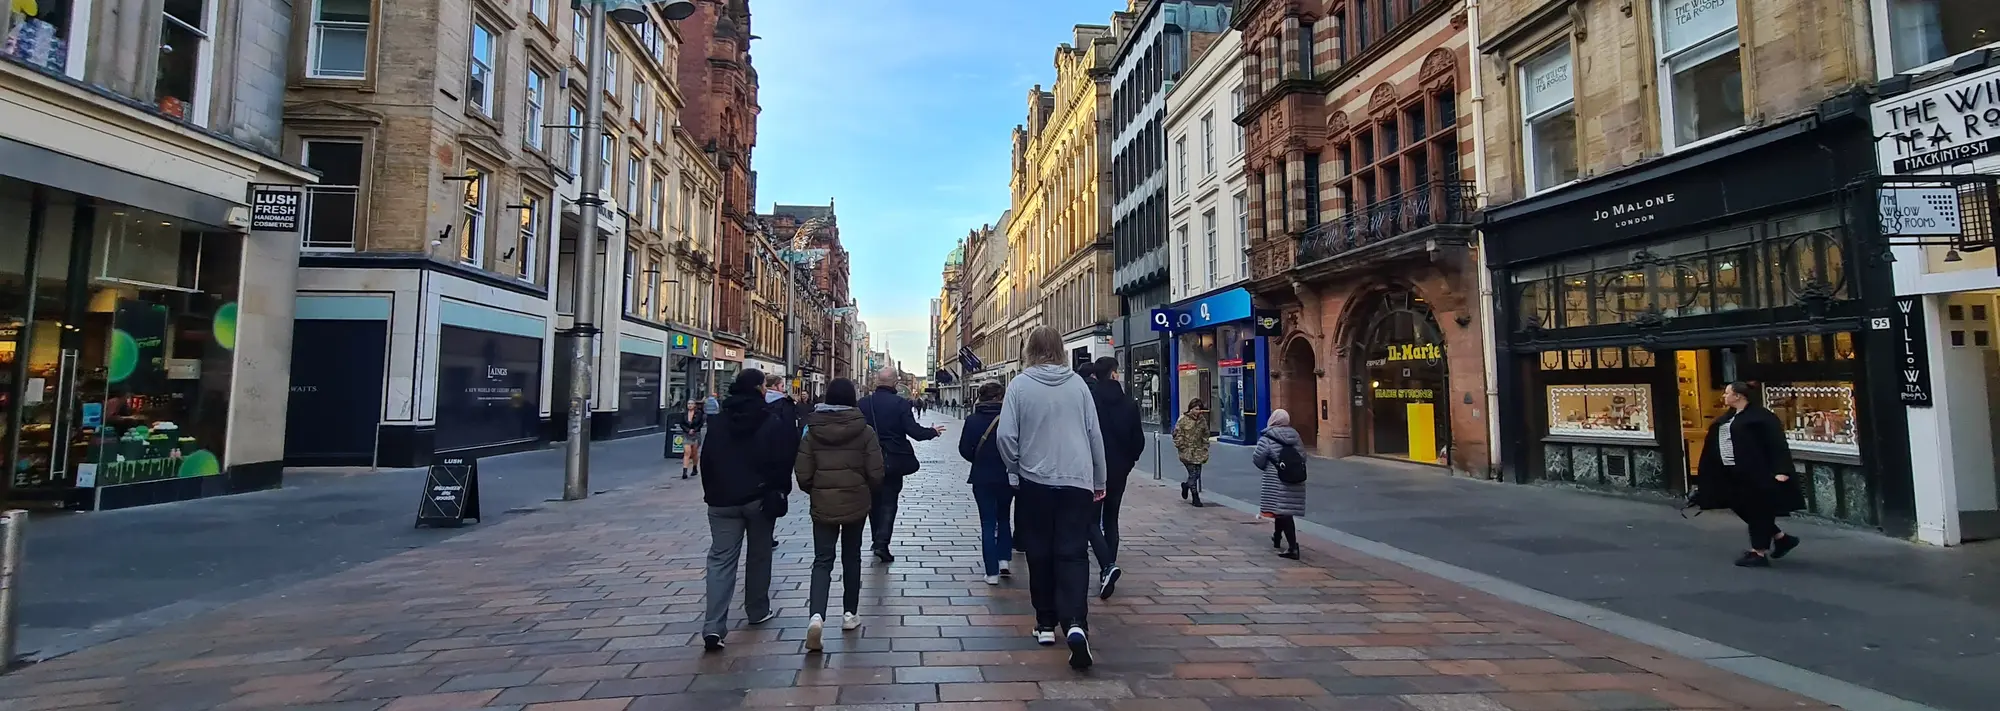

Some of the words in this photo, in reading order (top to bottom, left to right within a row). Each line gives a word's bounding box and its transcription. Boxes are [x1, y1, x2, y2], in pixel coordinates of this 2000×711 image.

[1674, 2, 1690, 17] THE
[1676, 13, 1691, 25] TEA
[1694, 0, 1725, 18] ROOMS
[1886, 98, 1939, 130] THE
[1890, 122, 1952, 155] TEA
[1905, 141, 1989, 171] MACKINTOSH
[256, 193, 297, 205] LUSH
[1612, 193, 1675, 216] MALONE
[1882, 195, 1896, 206] THE
[255, 204, 296, 215] FRESH
[1883, 206, 1920, 217] WILOW
[254, 214, 295, 222] HANDMADE
[1615, 214, 1655, 228] LONDON
[1904, 217, 1936, 228] ROOMS
[1873, 319, 1887, 327] 95
[1897, 300, 1920, 382] WILLOW
[487, 364, 508, 379] LAINGS
[1398, 389, 1433, 398] STRONG
[1905, 384, 1921, 393] TEA
[1901, 392, 1928, 400] ROOMS
